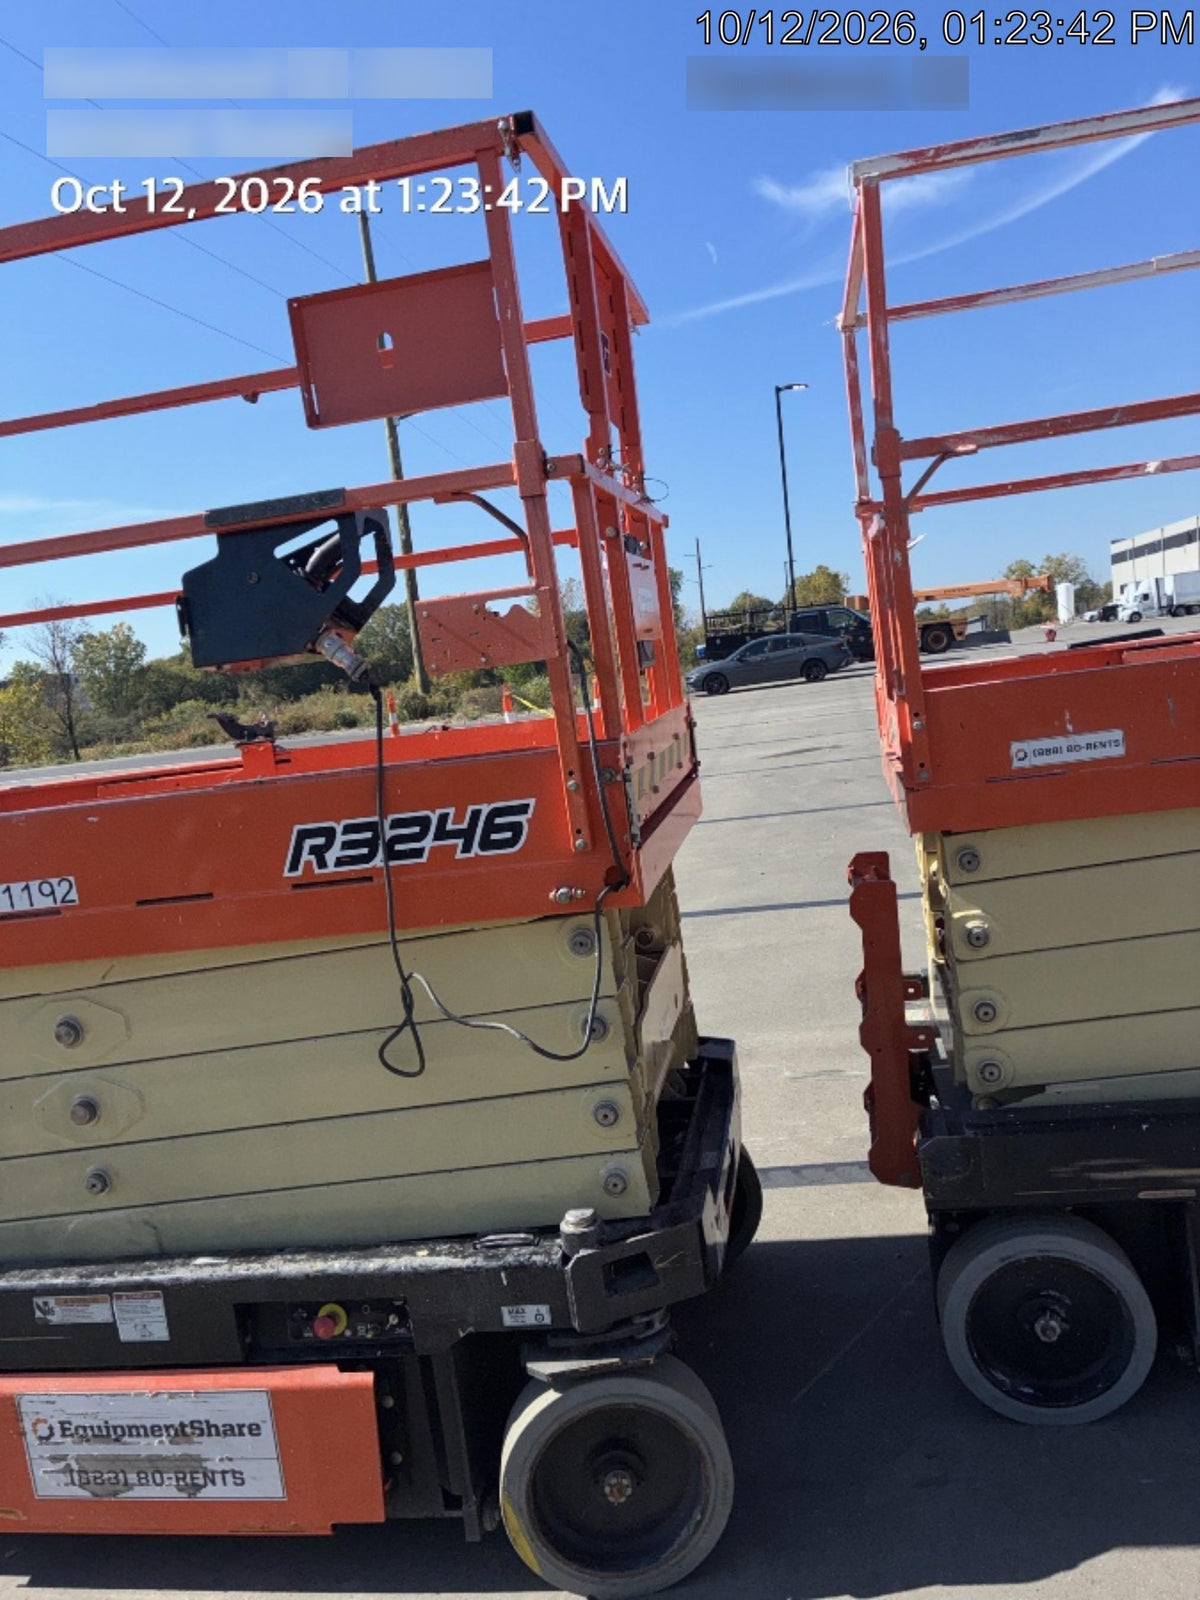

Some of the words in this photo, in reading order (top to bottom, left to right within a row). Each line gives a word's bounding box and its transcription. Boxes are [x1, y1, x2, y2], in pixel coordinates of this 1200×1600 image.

[284, 798, 535, 877] R3246
[2, 877, 77, 910] 1192
[58, 1420, 262, 1442] EquipmentShare
[136, 1467, 246, 1487] 80-RENTS
